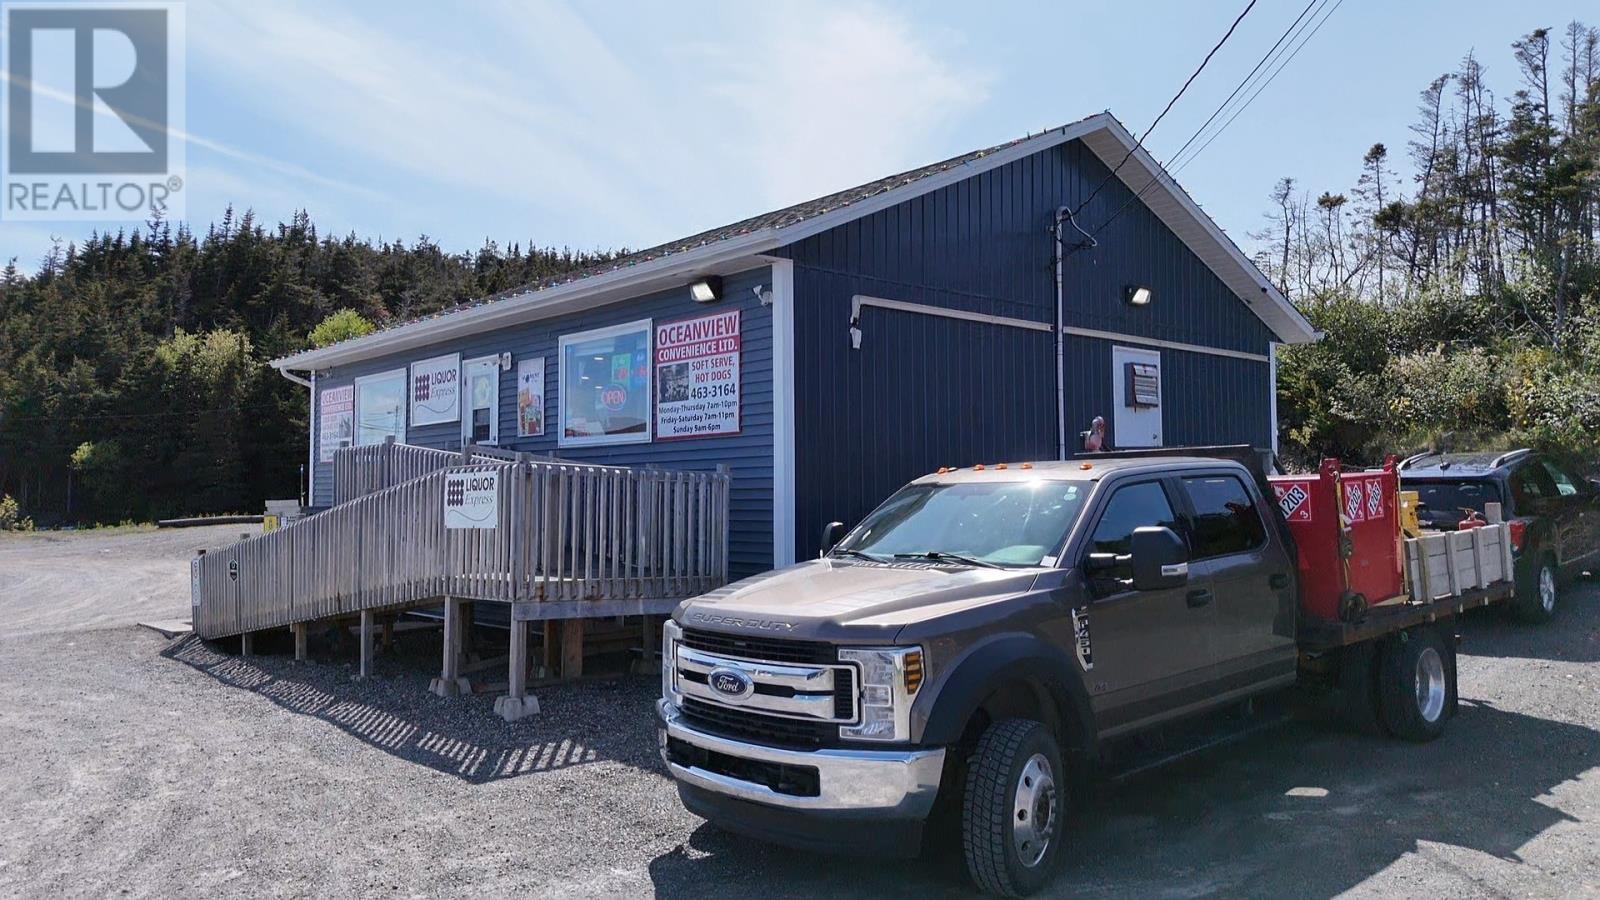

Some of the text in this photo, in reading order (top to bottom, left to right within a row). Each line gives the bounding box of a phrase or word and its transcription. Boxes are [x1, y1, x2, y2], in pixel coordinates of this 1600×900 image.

[659, 315, 737, 346] OCEANVIEW
[659, 338, 738, 361] CONVENIENCE LTD.
[691, 360, 709, 371] SOFT
[431, 368, 457, 385] LIQUOR
[695, 369, 732, 383] HOT DOGS
[691, 383, 736, 399] 463-3164
[659, 400, 737, 414] Monday-Thursday 7am-10pm
[661, 412, 735, 424] Friday-Saturday 7am-11pm
[673, 425, 694, 434] Sunday
[465, 477, 495, 492] LIQUOR
[691, 613, 800, 632] SUPER DUTY
[717, 675, 739, 692] Ford
